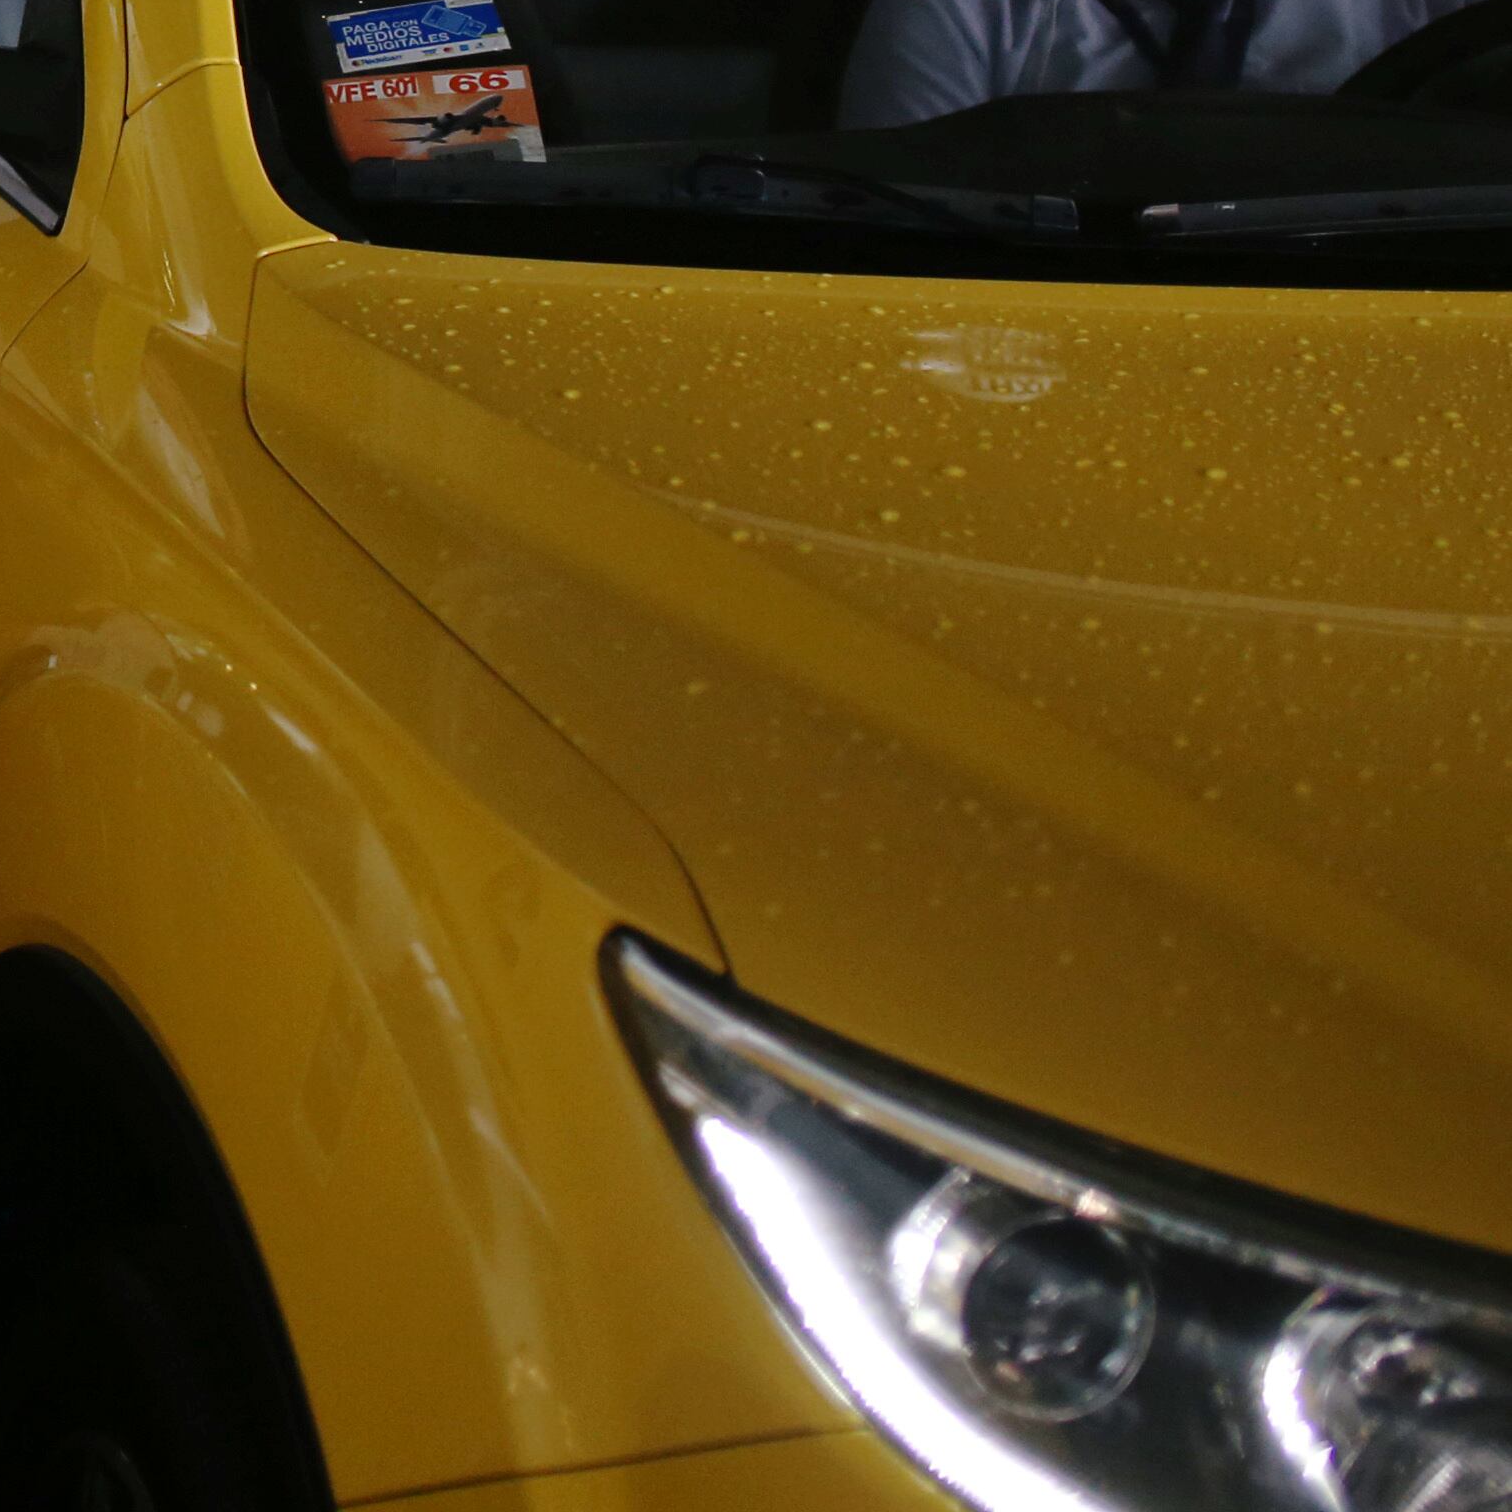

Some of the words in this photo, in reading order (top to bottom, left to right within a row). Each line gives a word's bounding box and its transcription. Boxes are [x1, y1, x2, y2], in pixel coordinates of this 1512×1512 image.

[342, 21, 390, 36] PAGA
[392, 19, 419, 29] CON
[345, 26, 422, 47] MEDIOS
[367, 32, 450, 53] DIGITALES
[326, 82, 378, 104] VFE
[381, 75, 418, 98] 601
[448, 70, 510, 94] 66
